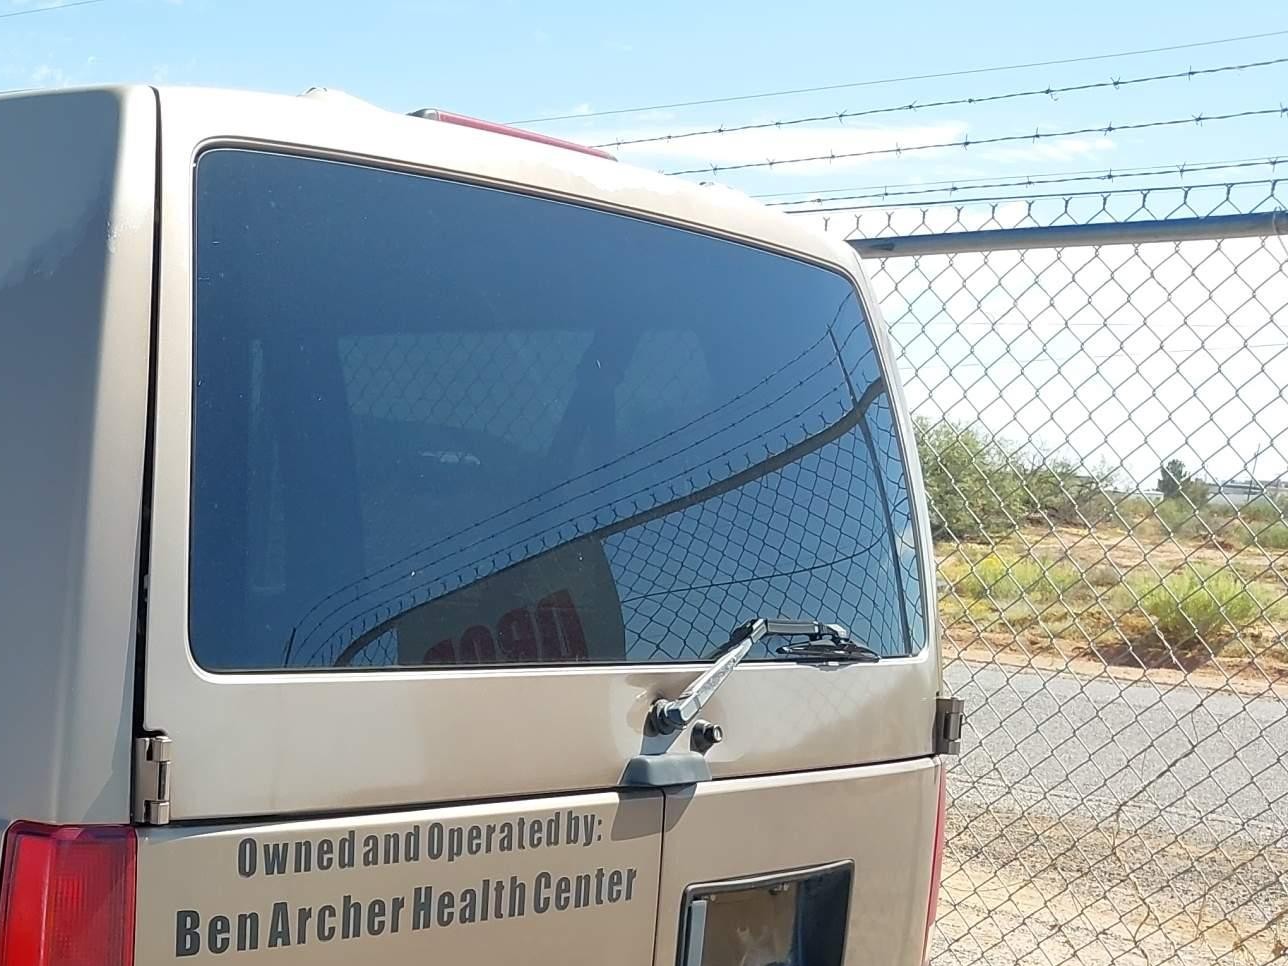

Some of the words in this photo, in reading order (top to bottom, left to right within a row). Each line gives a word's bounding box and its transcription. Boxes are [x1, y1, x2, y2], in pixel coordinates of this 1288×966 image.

[237, 830, 355, 878] Owned
[363, 825, 420, 866] and
[427, 810, 561, 862] Operated
[565, 810, 602, 849] by:
[175, 909, 259, 957] Ben
[268, 894, 404, 948] Archer
[412, 875, 525, 931] Health
[533, 865, 637, 914] Center
